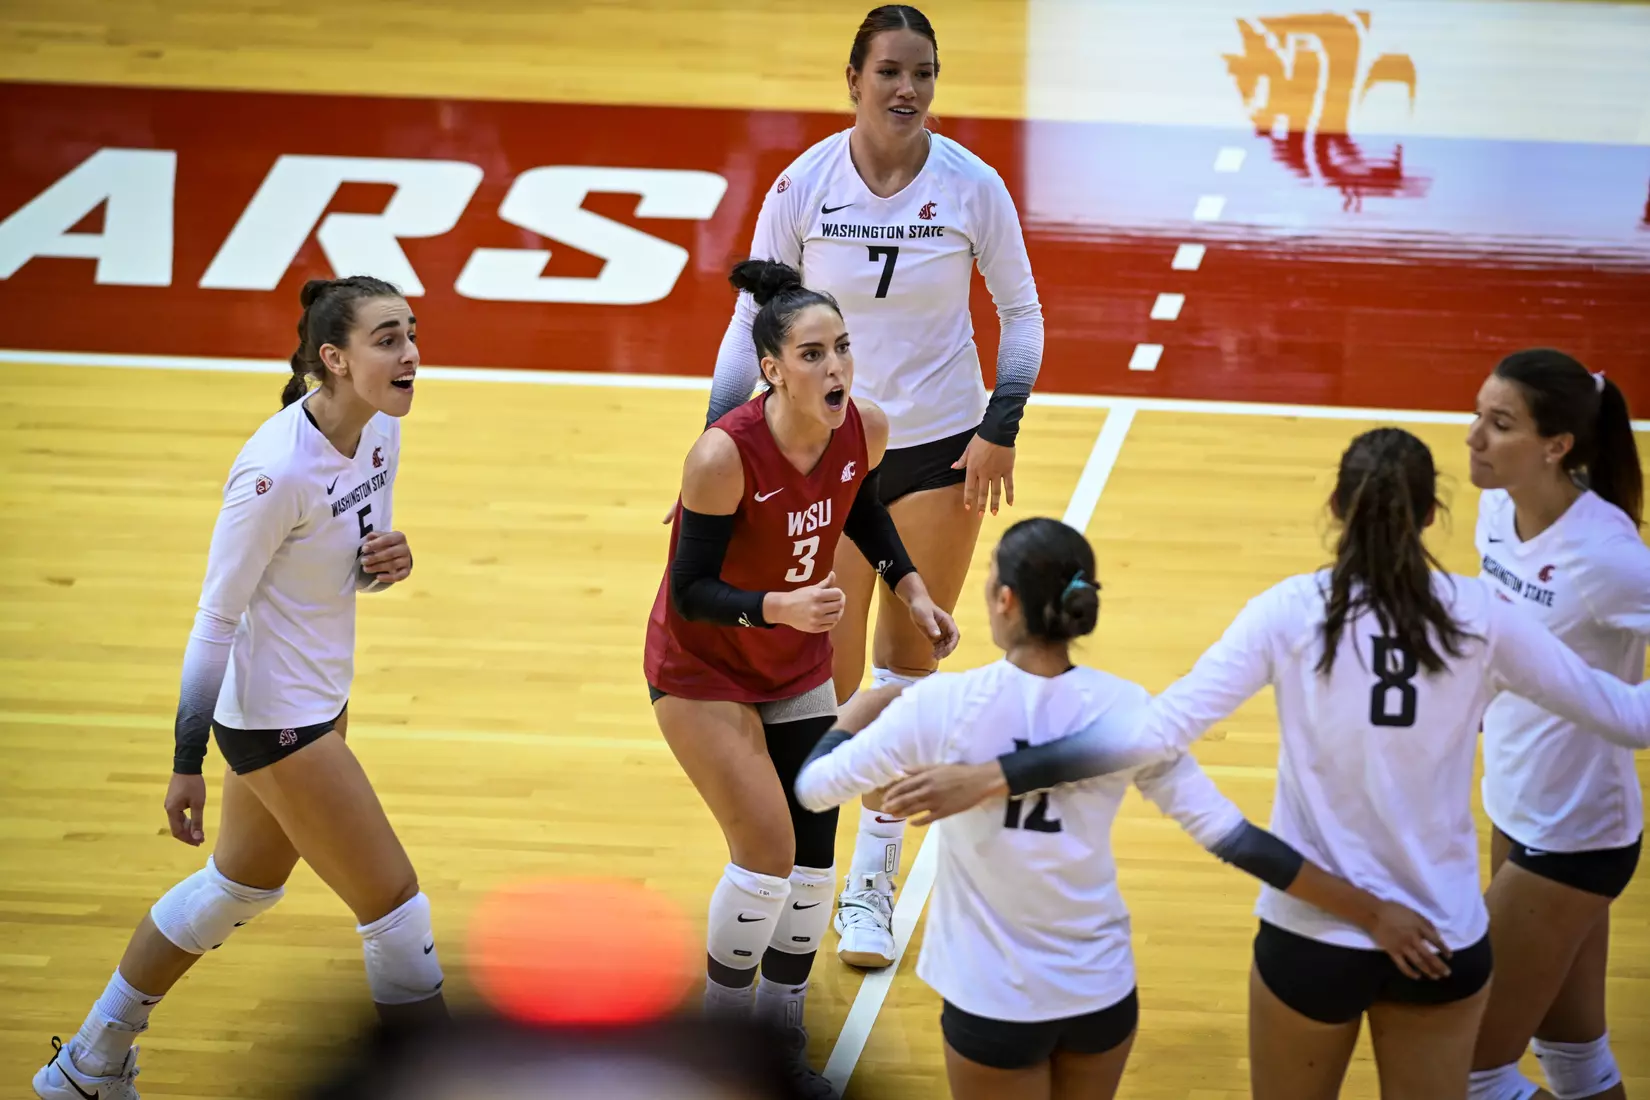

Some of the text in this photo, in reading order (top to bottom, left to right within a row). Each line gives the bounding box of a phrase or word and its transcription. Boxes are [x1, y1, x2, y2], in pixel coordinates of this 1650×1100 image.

[0, 147, 728, 305] ARS
[821, 223, 945, 239] WASHINGTON STATE
[866, 245, 899, 298] 7
[331, 479, 373, 518] WASHINGTON
[787, 498, 832, 537] WSU
[784, 535, 820, 583] 3
[1523, 582, 1556, 607] STATE
[1369, 634, 1418, 728] 8
